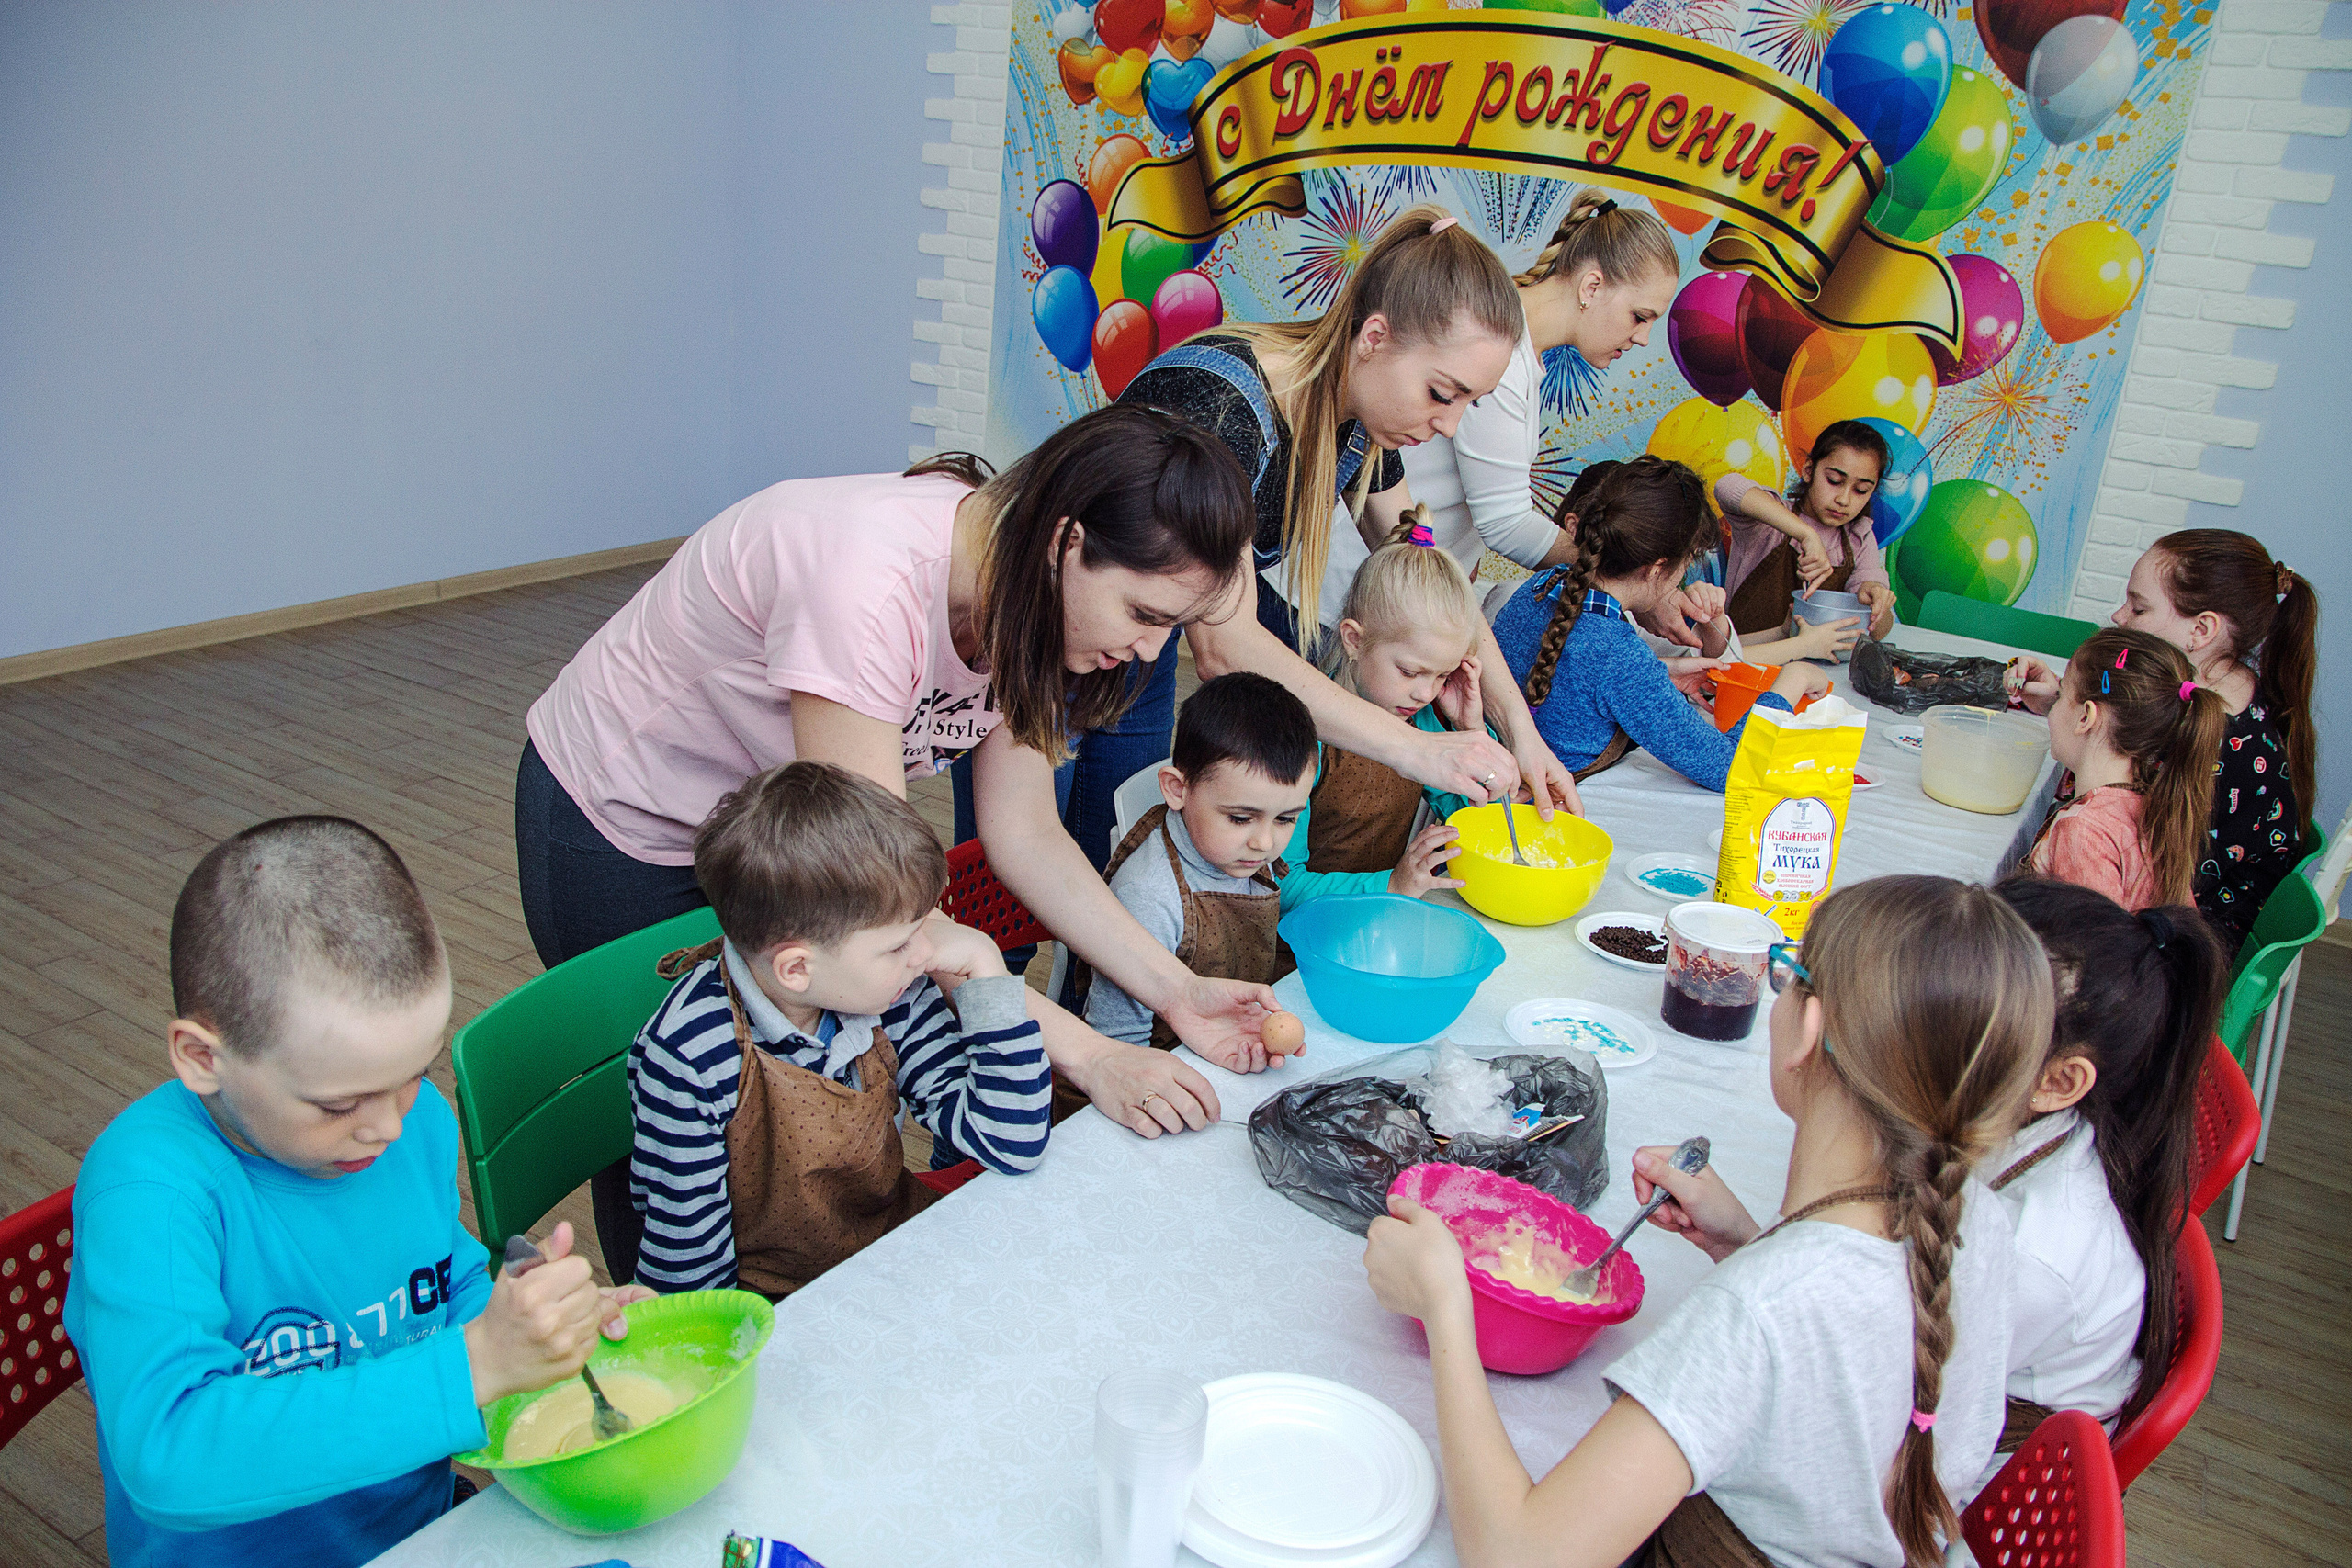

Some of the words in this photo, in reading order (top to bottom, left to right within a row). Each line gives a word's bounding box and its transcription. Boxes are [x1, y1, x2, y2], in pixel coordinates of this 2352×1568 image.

[1269, 43, 1453, 145] Днём
[1455, 39, 1874, 222] рождения!
[933, 718, 988, 740] Style
[1768, 829, 1827, 842] КУБАНСКАЯ
[1773, 843, 1820, 854] Тихорецкая
[1784, 907, 1800, 917] 2кг
